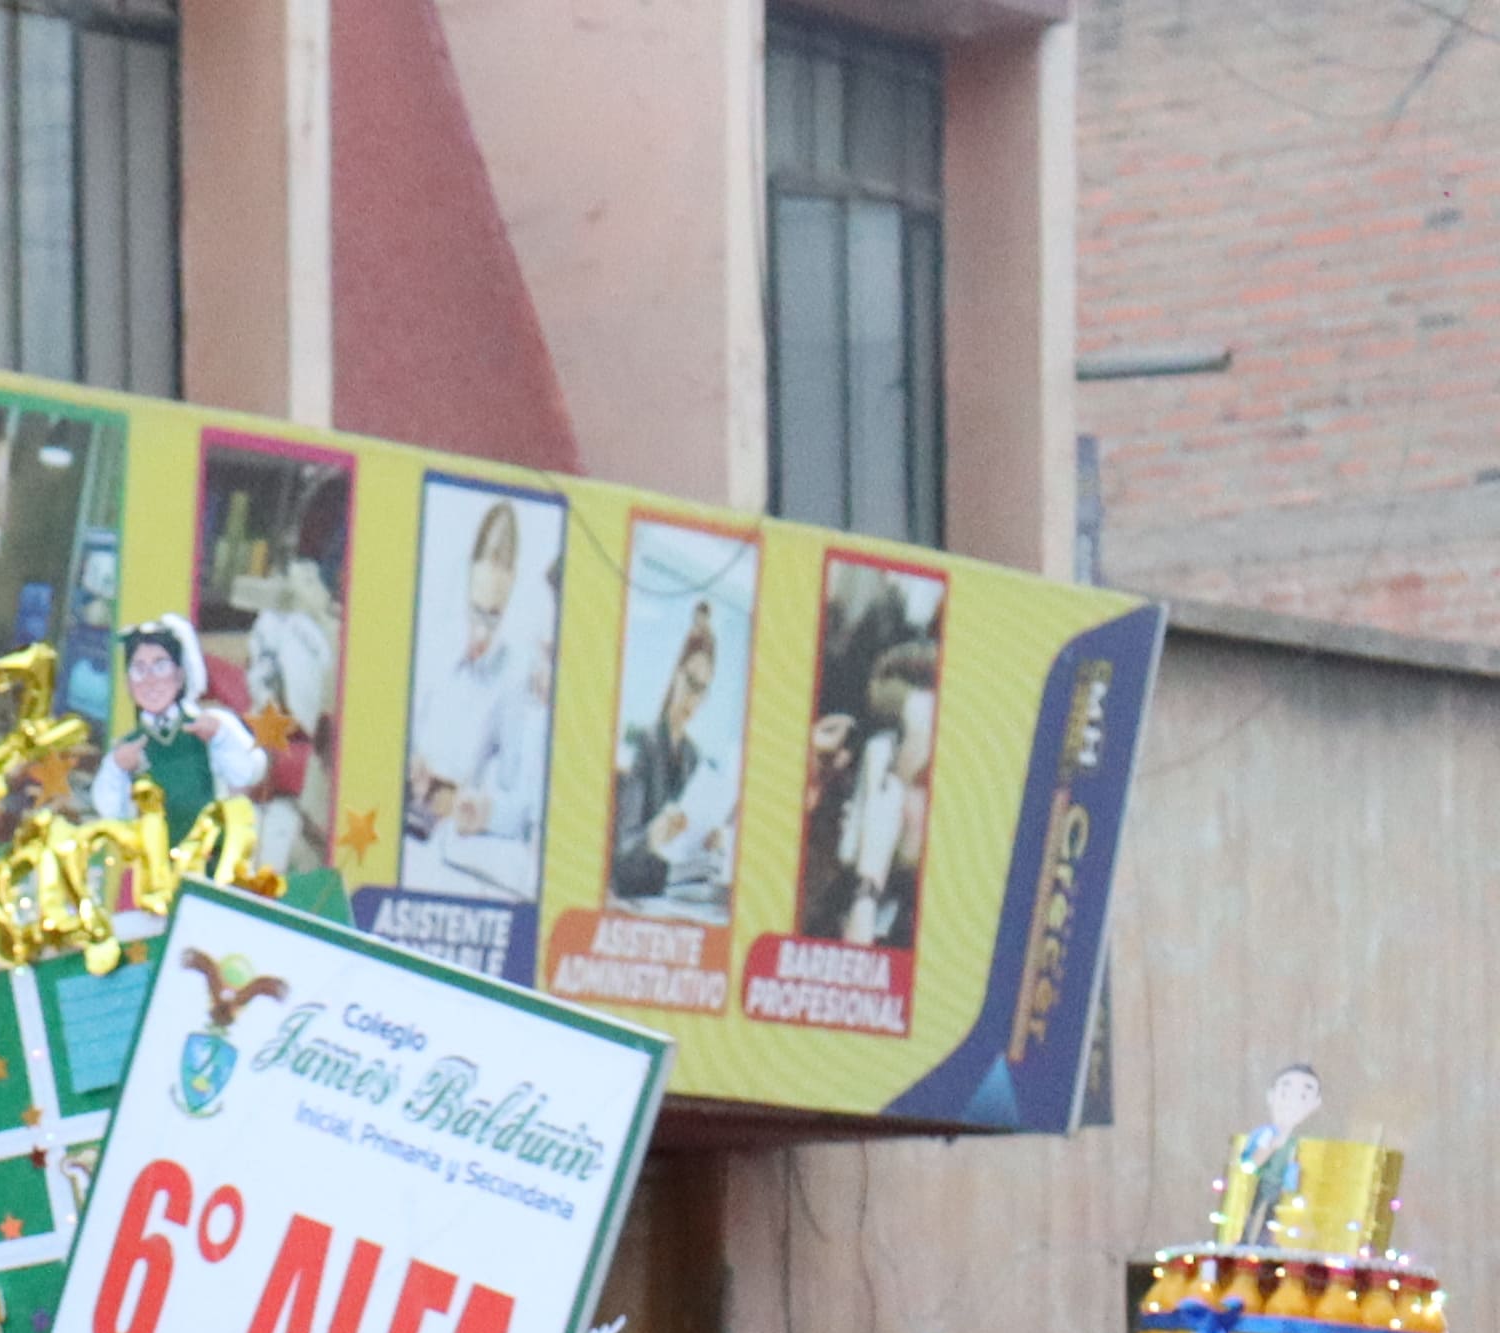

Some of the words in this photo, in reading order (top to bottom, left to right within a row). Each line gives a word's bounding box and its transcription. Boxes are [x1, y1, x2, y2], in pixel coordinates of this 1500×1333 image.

[373, 901, 514, 948] ASISTENTE
[591, 917, 706, 962] ASISTENTE
[342, 1003, 428, 1052] Colegio
[250, 1002, 403, 1106] James
[402, 1054, 605, 1182] Baldwin
[359, 1122, 443, 1173] Primaria
[463, 1160, 576, 1221] Secundaria
